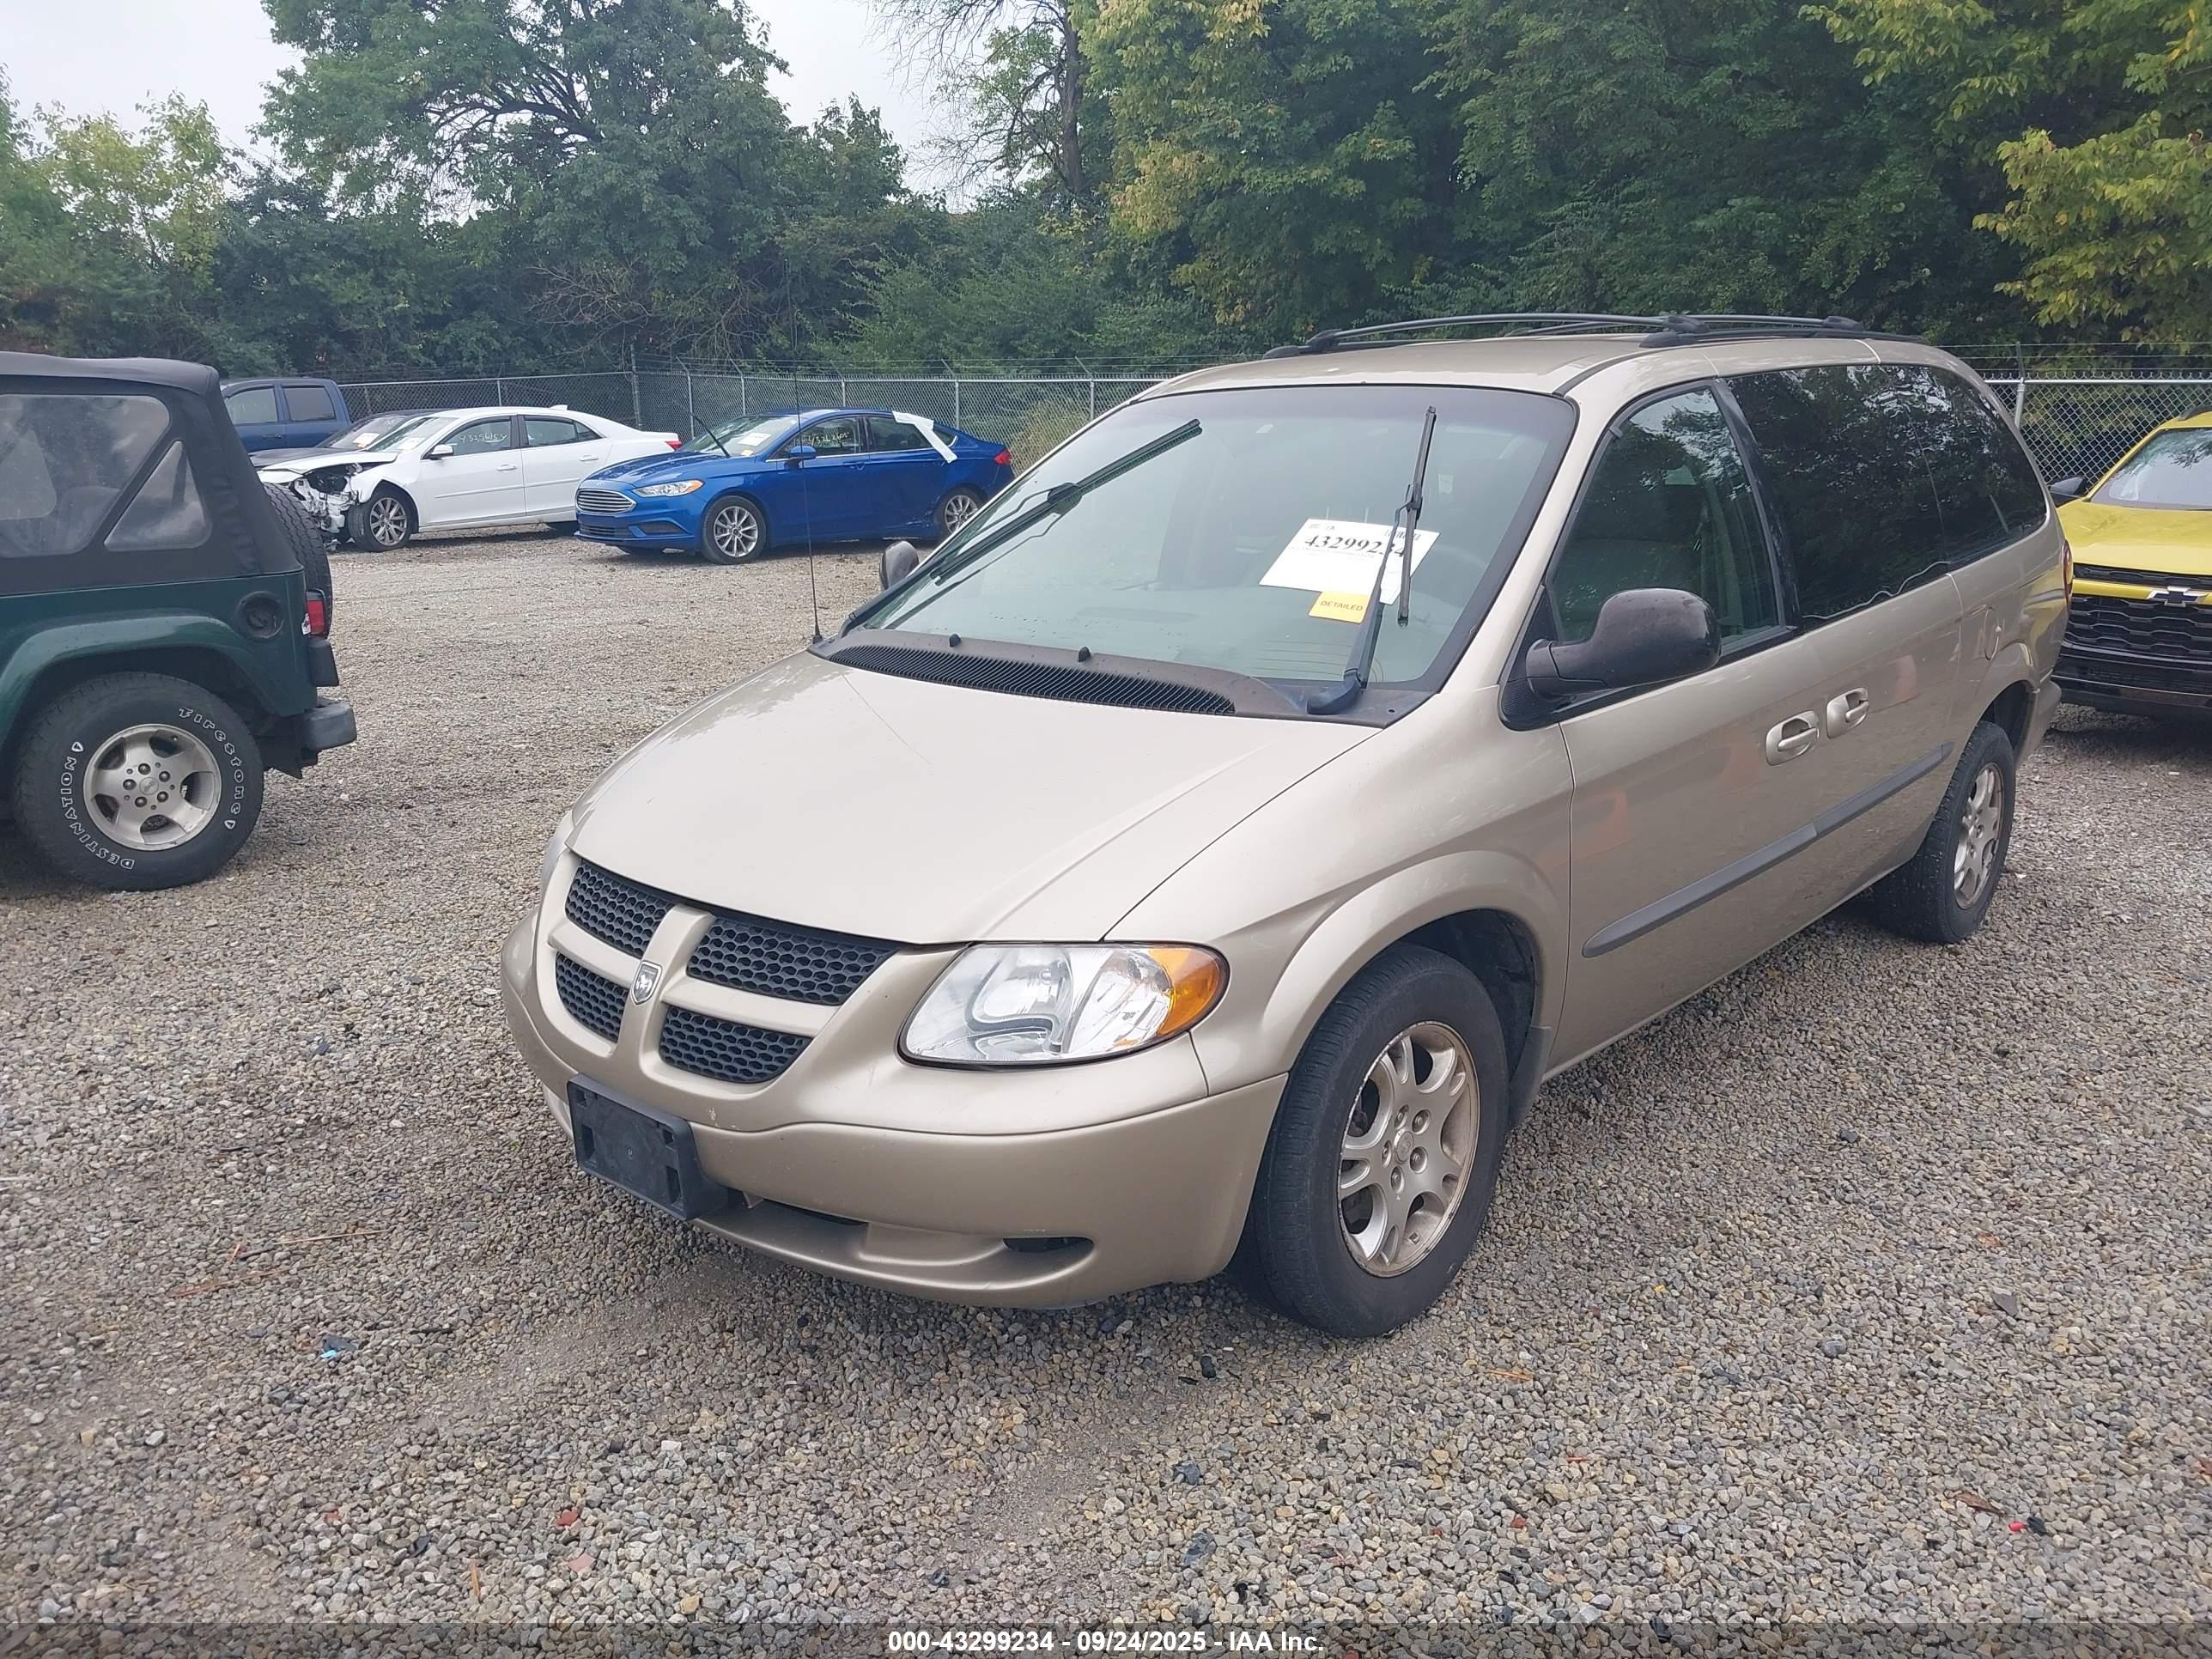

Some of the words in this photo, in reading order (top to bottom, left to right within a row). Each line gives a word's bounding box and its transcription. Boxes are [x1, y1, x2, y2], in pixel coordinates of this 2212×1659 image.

[1321, 600, 1363, 611] DETAILED
[61, 757, 136, 869] DESTINATION
[179, 708, 244, 814] Firestone
